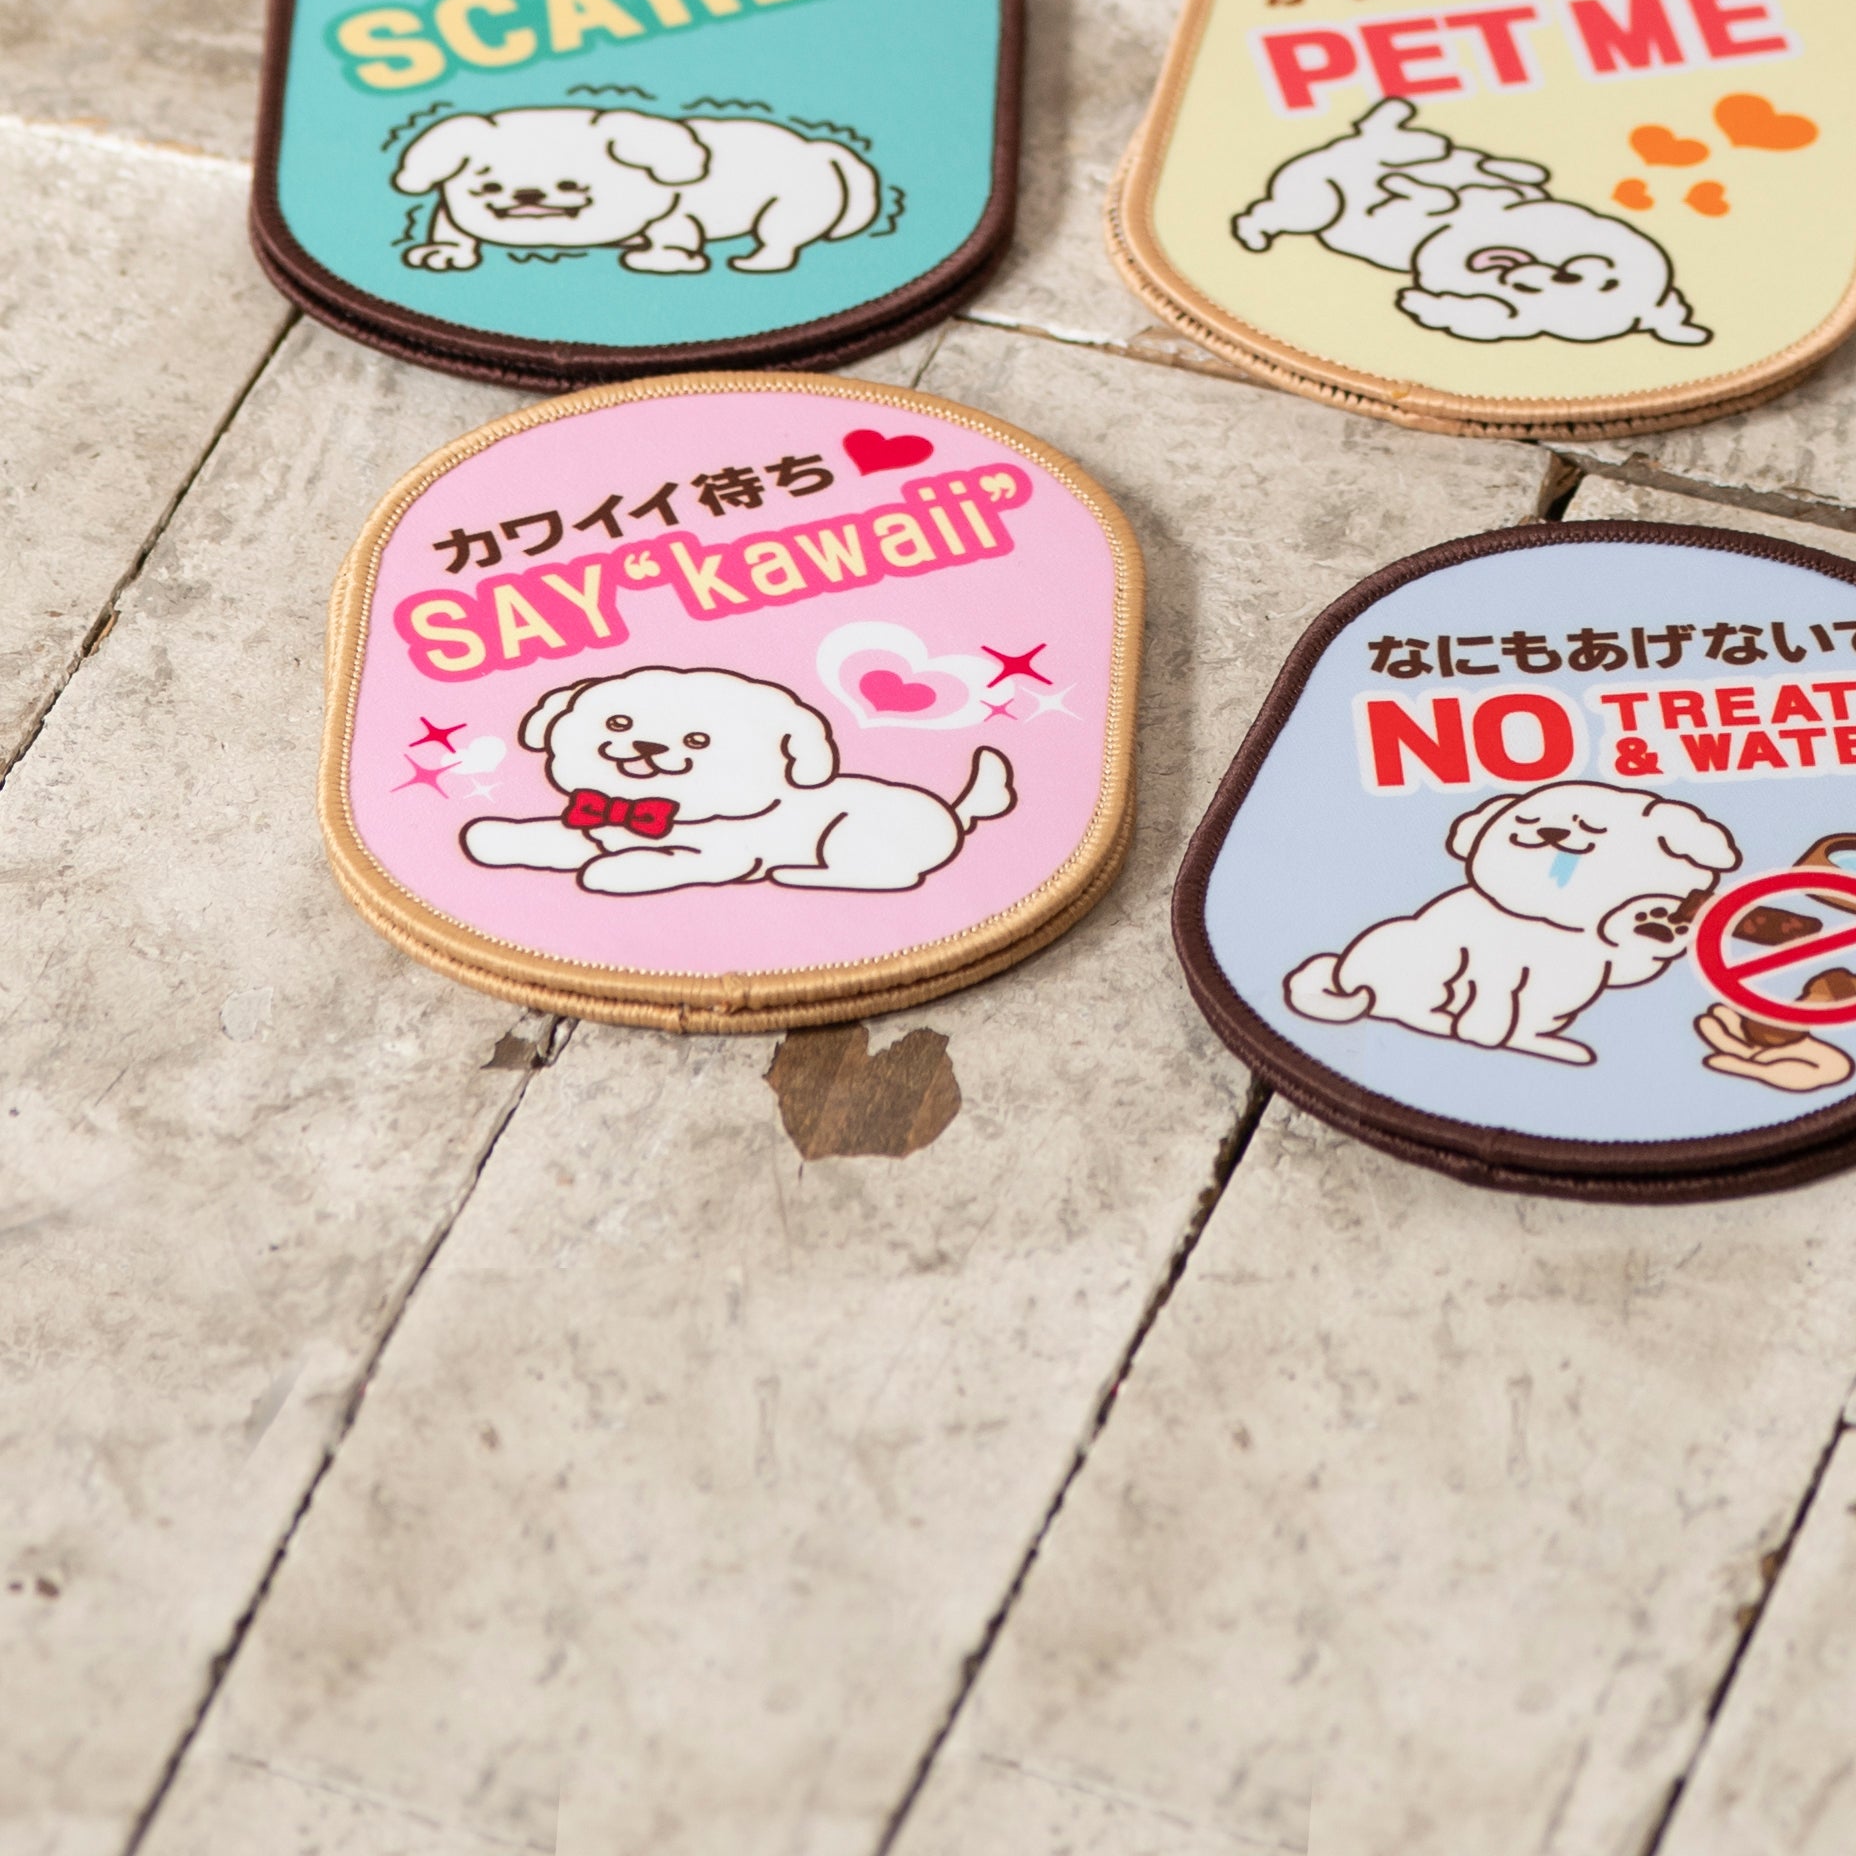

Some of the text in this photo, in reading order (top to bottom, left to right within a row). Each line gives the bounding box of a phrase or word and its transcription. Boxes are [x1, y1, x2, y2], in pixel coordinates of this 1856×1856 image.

[1261, 6, 1539, 109] PET
[433, 453, 835, 574] カワイイ待ち
[1365, 694, 1576, 787] NO
[1615, 736, 1664, 777] &
